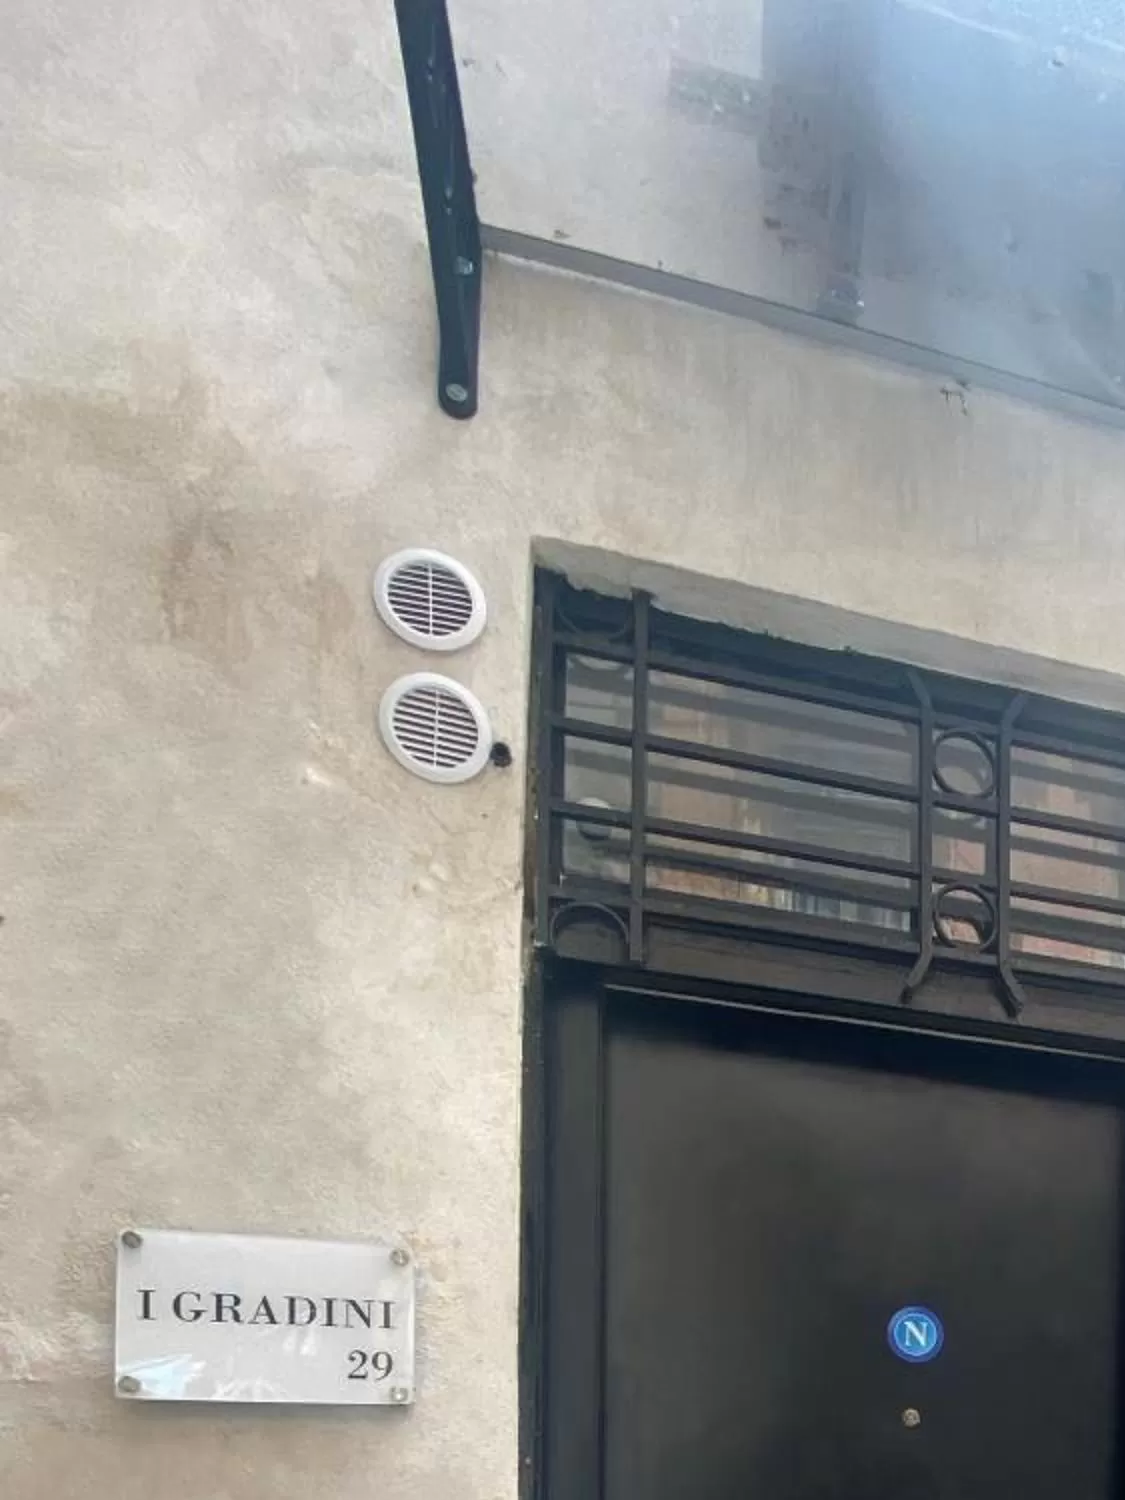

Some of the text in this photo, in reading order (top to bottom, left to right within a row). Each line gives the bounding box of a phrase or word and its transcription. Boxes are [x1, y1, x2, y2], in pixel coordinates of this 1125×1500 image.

[137, 1288, 396, 1329] I GRADINI
[904, 1321, 929, 1347] N
[347, 1349, 394, 1381] 29
